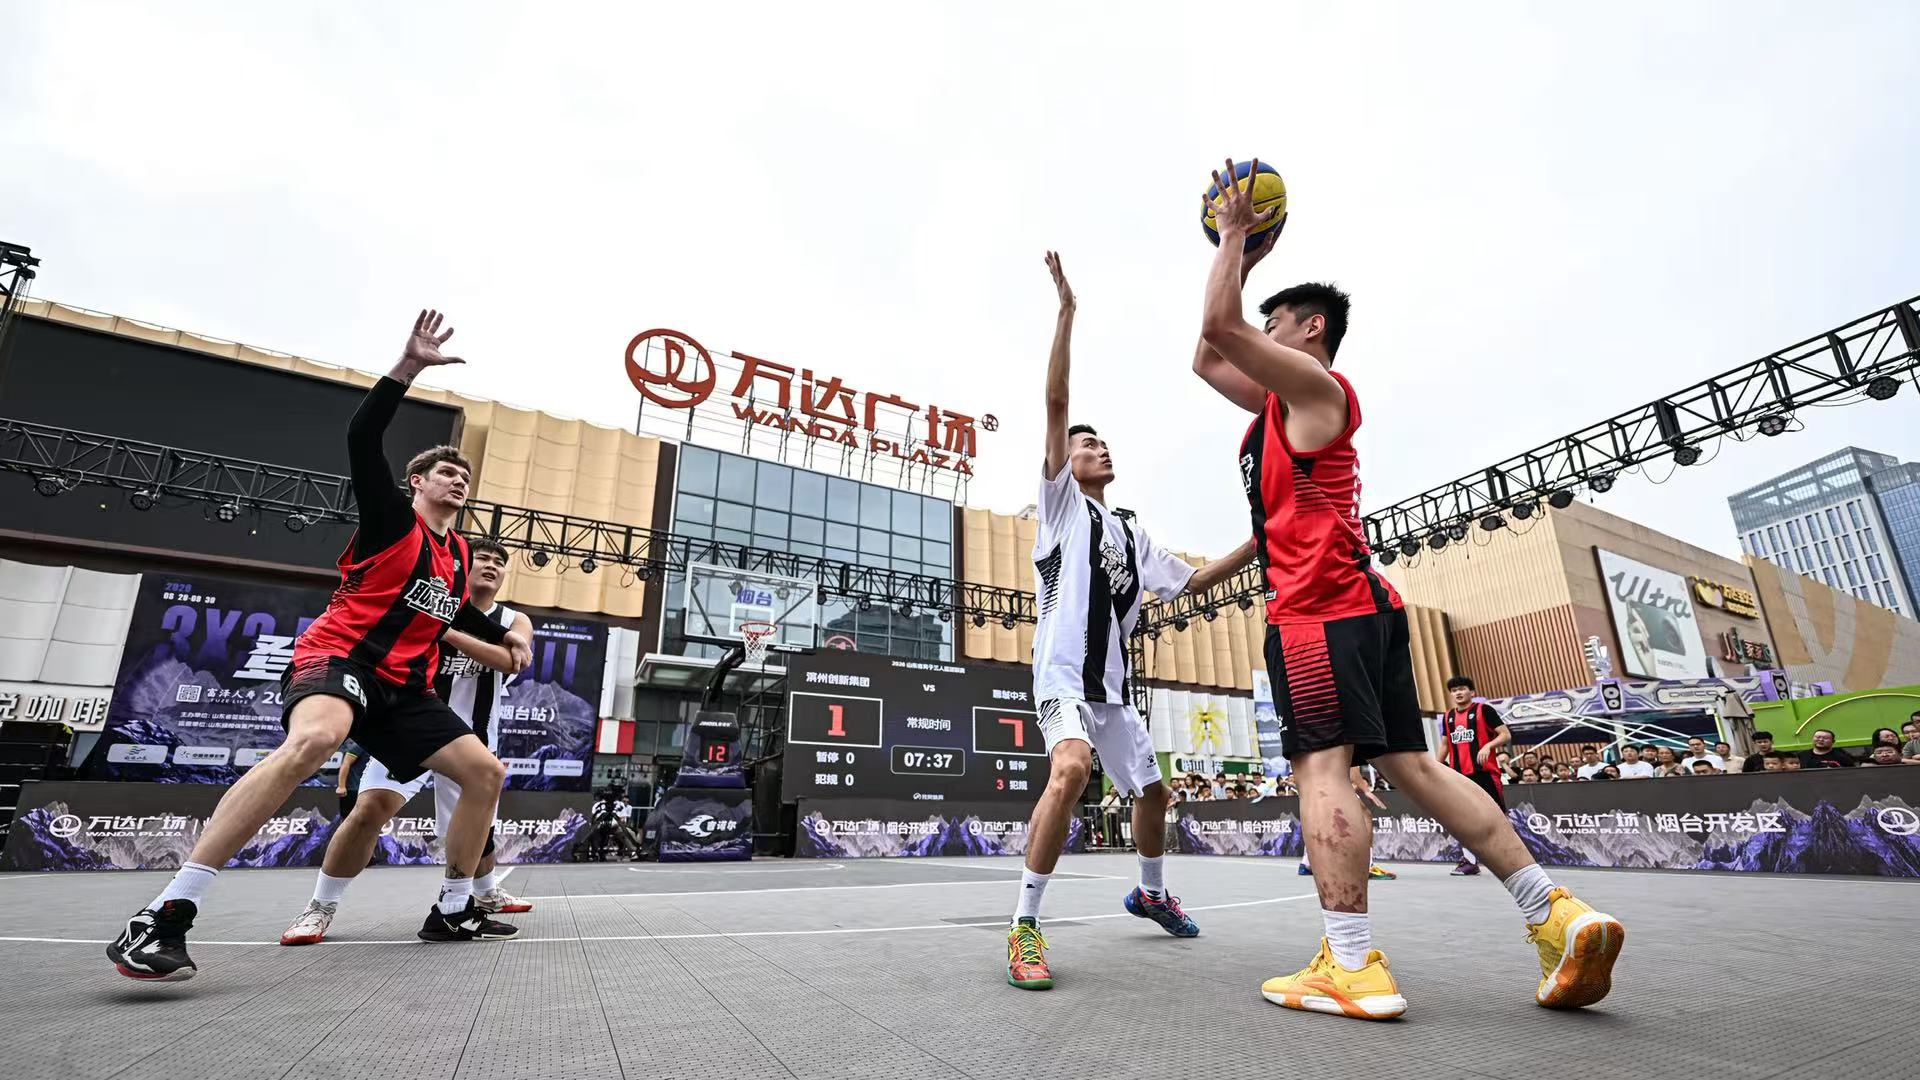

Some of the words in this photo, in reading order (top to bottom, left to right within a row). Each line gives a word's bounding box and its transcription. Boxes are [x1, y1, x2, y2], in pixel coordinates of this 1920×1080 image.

[731, 351, 976, 458] 万达广场
[731, 403, 859, 448] WANDA
[871, 438, 974, 476] PLAZA
[736, 588, 772, 607] 烟台
[1609, 571, 1691, 619] Ultra
[806, 672, 870, 687] 滨州创新集团
[923, 684, 936, 692] VS
[828, 705, 846, 736] 1
[906, 716, 951, 731] 常规时间
[998, 718, 1024, 747] 7
[708, 745, 726, 762] 12
[816, 751, 839, 763] 暂停
[845, 752, 855, 764] 0
[903, 752, 953, 768] 07:37
[996, 759, 1004, 771] 0
[1009, 760, 1028, 771] 暂停
[815, 773, 839, 785] 犯规
[845, 774, 854, 786] 0
[996, 779, 1004, 790] 3
[1009, 780, 1028, 791] 犯规
[87, 815, 187, 830] 万达广场
[832, 820, 880, 832] 万达广场
[886, 821, 940, 835] 烟台开发区
[983, 821, 1023, 832] 万达广场
[1201, 820, 1237, 831] 万达广场
[1242, 820, 1292, 833] 烟台开发区
[1401, 817, 1444, 833] 烟台开
[1555, 814, 1640, 828] 万达广场
[1655, 813, 1787, 833] 烟台开发区
